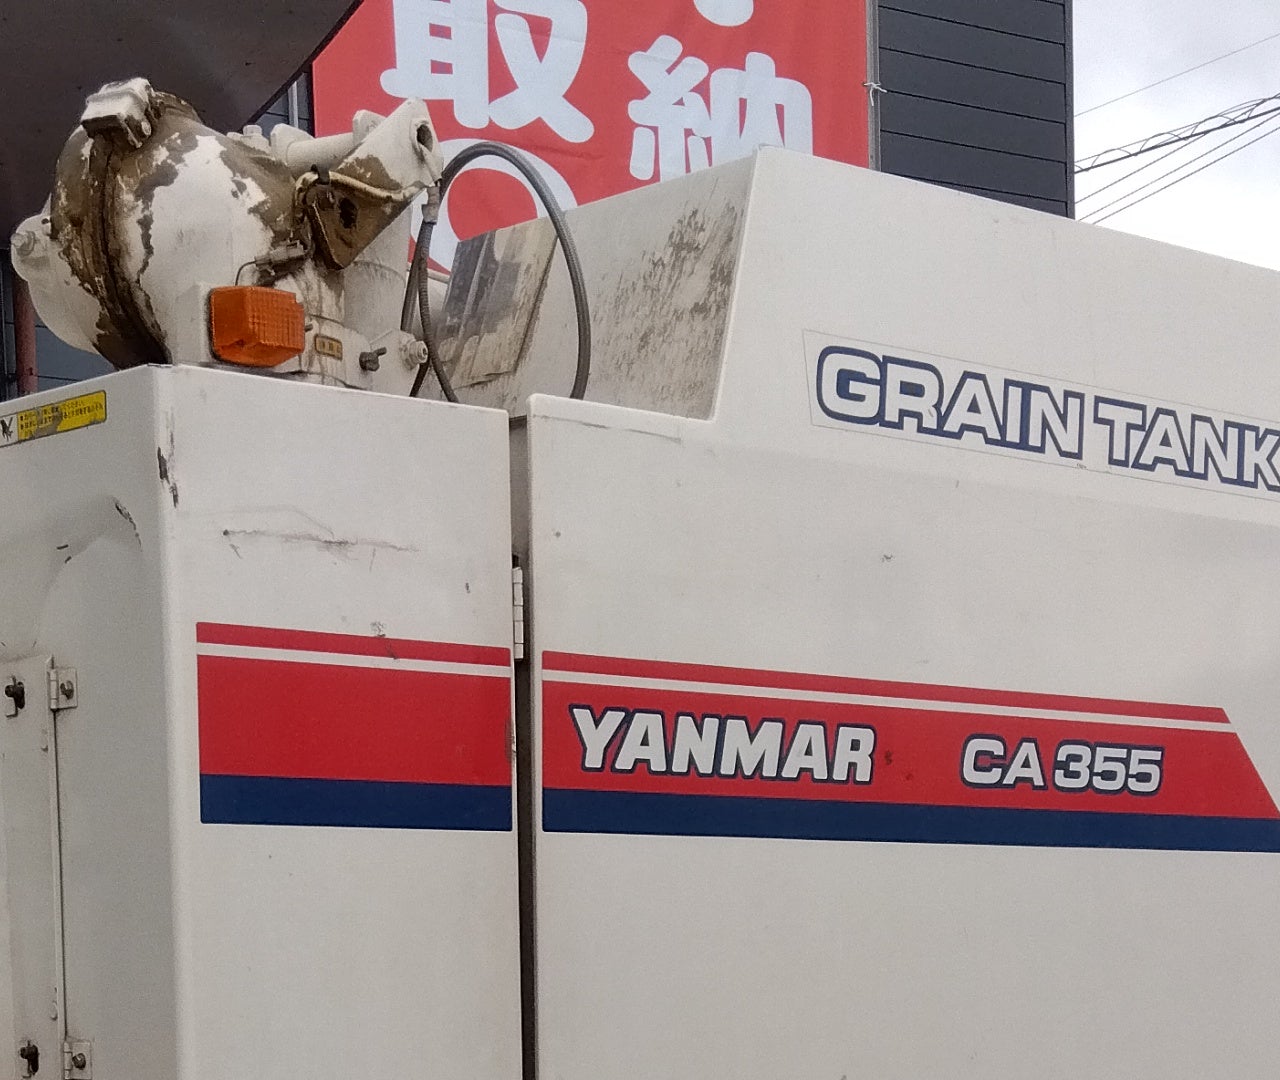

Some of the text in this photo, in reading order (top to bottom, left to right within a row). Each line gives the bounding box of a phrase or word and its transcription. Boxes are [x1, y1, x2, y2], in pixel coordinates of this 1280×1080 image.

[628, 0, 812, 182] 納
[816, 346, 1086, 461] GRAIN
[569, 704, 1164, 794] YANMAR CA 355
